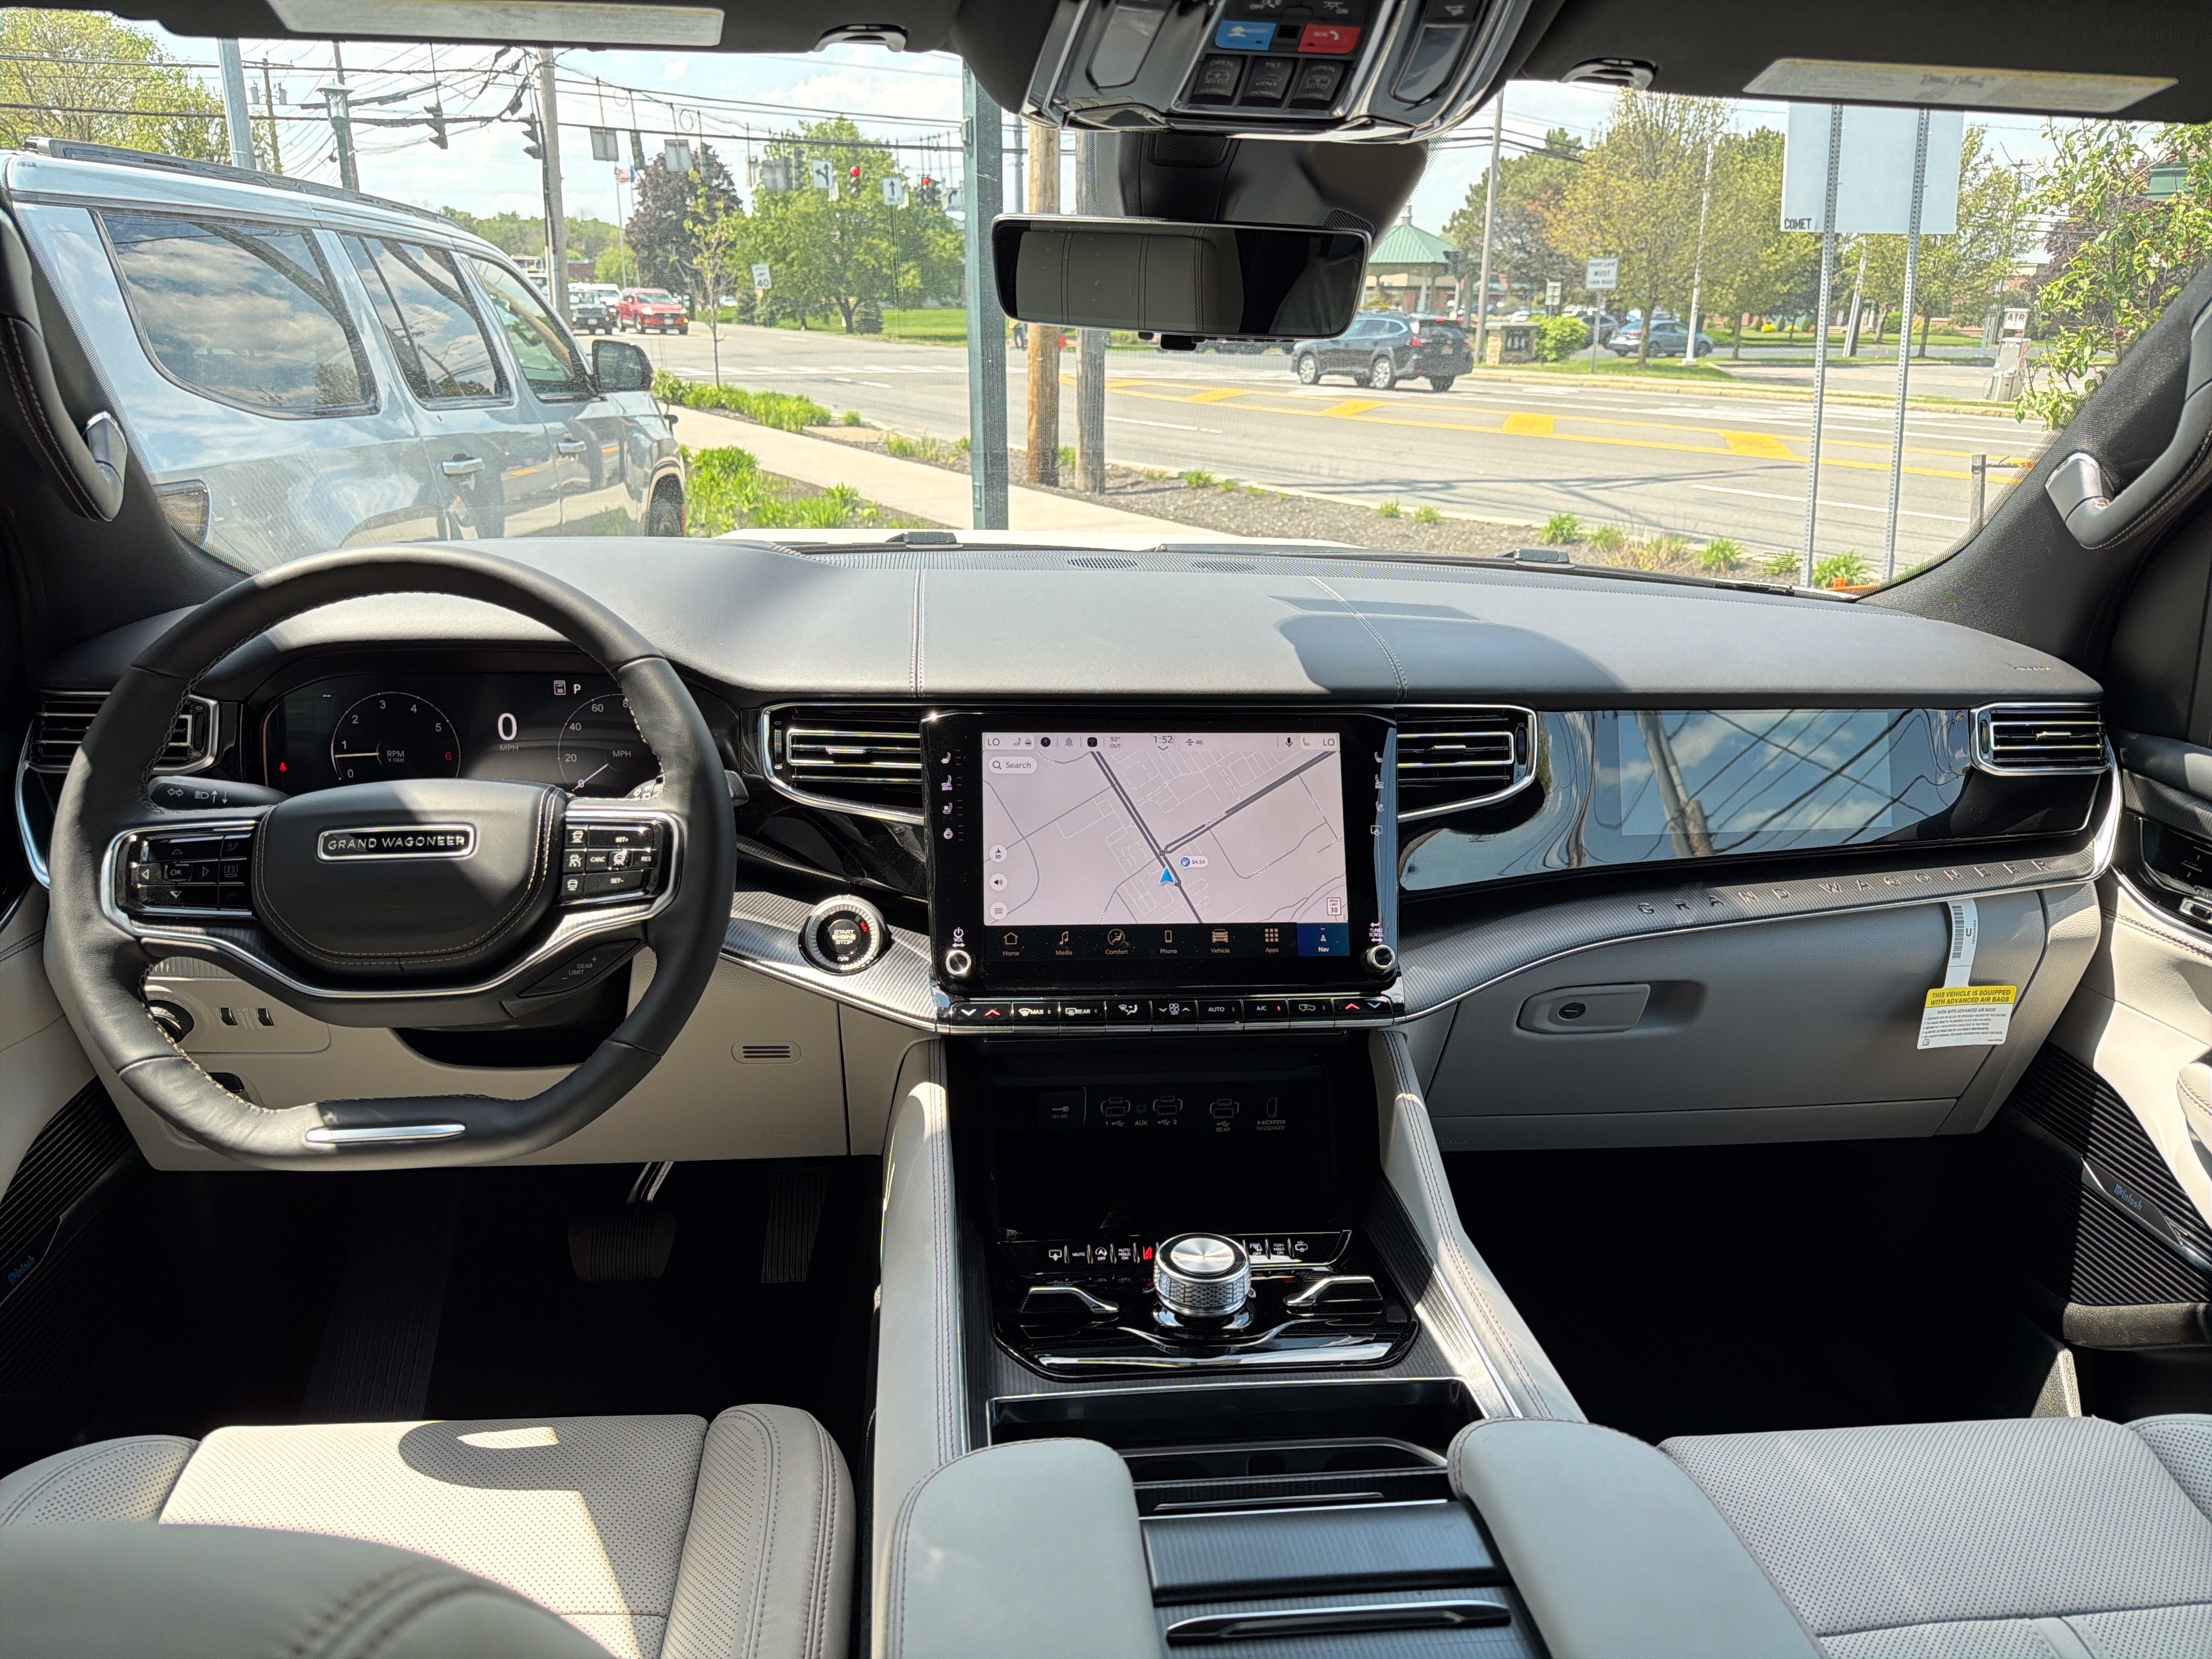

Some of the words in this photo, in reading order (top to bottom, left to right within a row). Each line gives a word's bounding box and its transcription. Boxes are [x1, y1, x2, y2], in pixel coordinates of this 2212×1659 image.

[1784, 218, 1812, 230] COMET
[757, 279, 770, 287] 40
[2007, 313, 2025, 321] AIR
[574, 684, 581, 695] P
[380, 700, 386, 709] 3
[410, 704, 417, 713] 4
[592, 704, 603, 712] 60
[352, 715, 359, 724] 2
[436, 723, 442, 732] 5
[498, 713, 517, 741] 0
[569, 723, 582, 731] 40
[988, 738, 1000, 746] LO
[1153, 735, 1173, 743] 1:52
[1323, 738, 1335, 746] LO
[342, 740, 347, 749] 1
[445, 752, 452, 761] 6
[565, 754, 577, 762] 20
[348, 769, 354, 778] 0
[578, 779, 584, 788] 0
[329, 838, 377, 850] GRAND
[382, 835, 465, 848] WAGONEER
[1638, 887, 1790, 915] GRAND
[1820, 858, 2052, 894] WAGONEER
[860, 921, 868, 933] RUN
[2113, 1183, 2142, 1212] McIntosh
